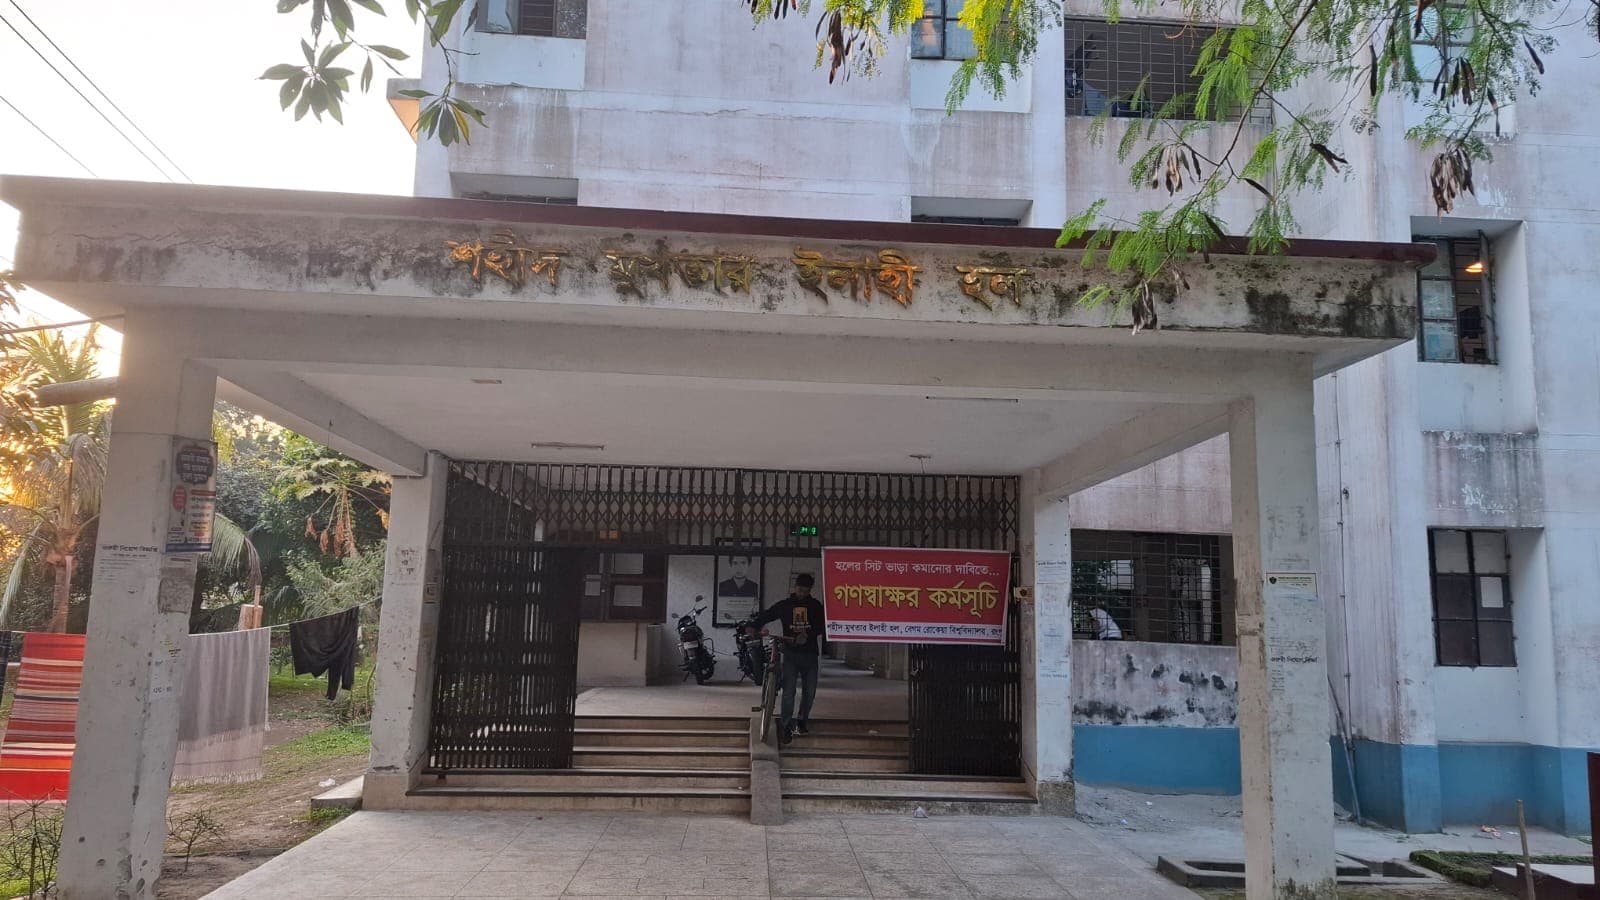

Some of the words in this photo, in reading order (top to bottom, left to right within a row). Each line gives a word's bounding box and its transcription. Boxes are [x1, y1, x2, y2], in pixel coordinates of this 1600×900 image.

[443, 228, 569, 287] শহীদ
[792, 246, 923, 309] ইলাহী
[955, 264, 1033, 311] হল
[834, 561, 860, 573] হলের
[864, 559, 882, 573] সিট
[885, 562, 908, 576] ভাড়া
[912, 562, 952, 574] কমানোর
[834, 583, 922, 609] গণস্বাক্ষর
[926, 580, 999, 619] কর্মসূচি
